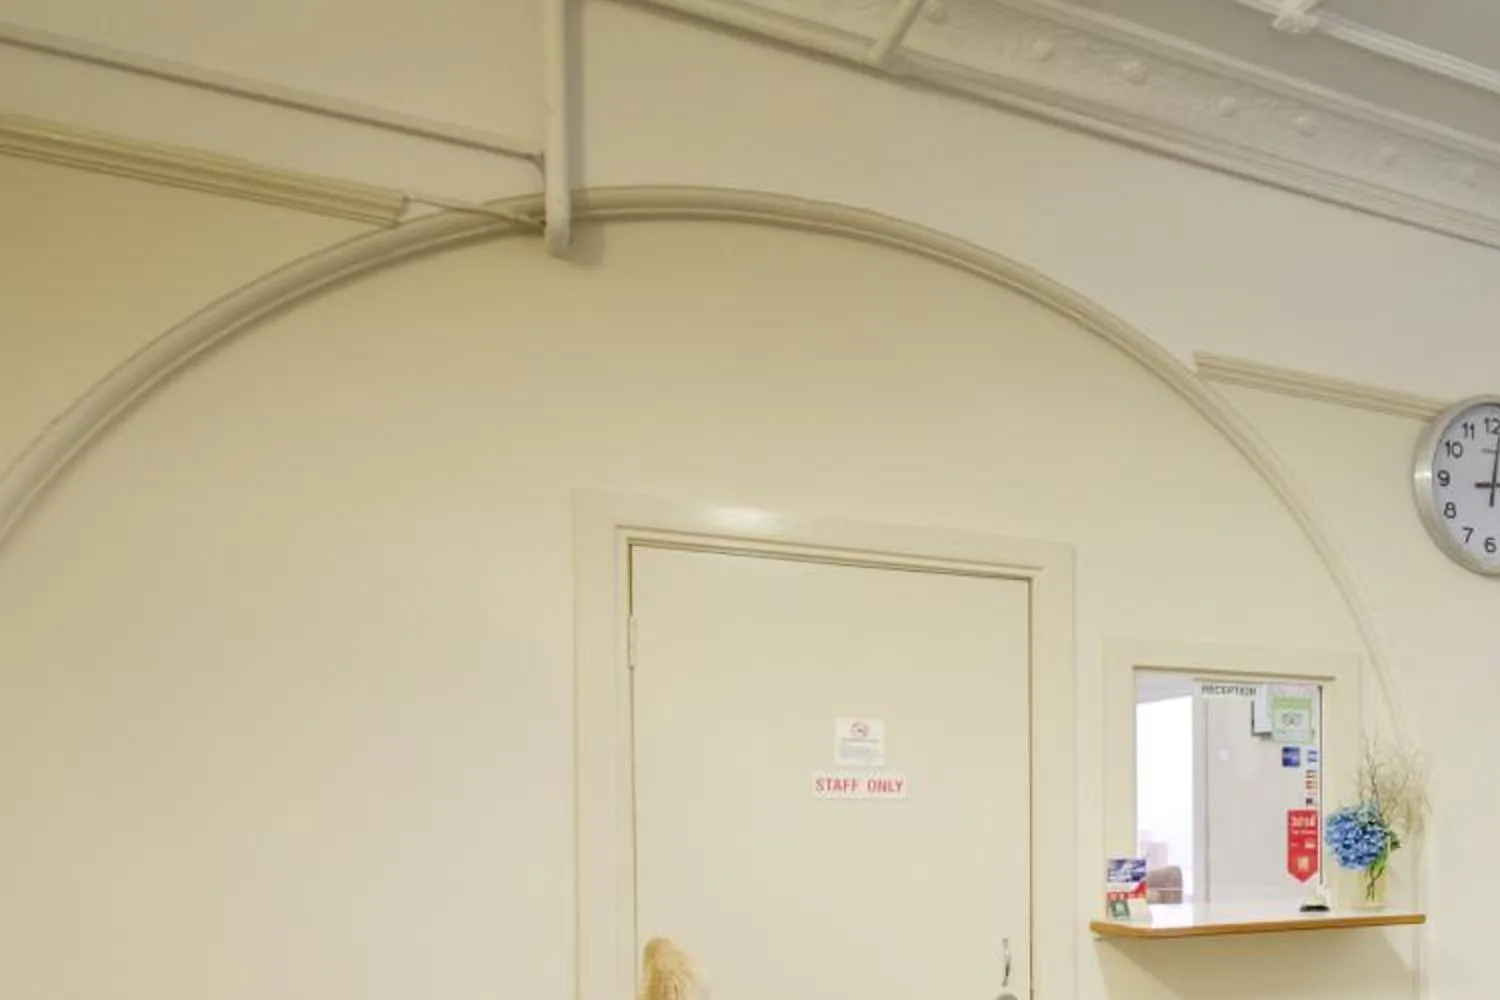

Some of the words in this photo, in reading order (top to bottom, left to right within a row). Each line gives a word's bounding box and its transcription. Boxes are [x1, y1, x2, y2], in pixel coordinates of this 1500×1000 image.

[1462, 422, 1475, 440] 11
[1444, 440, 1464, 458] 10
[1437, 470, 1449, 486] 9
[1444, 502, 1456, 518] 8
[1462, 527, 1474, 544] 7
[1484, 537, 1497, 553] 6
[1201, 684, 1256, 696] RECEPTION
[815, 778, 858, 793] STAFF
[867, 778, 903, 793] ONLY
